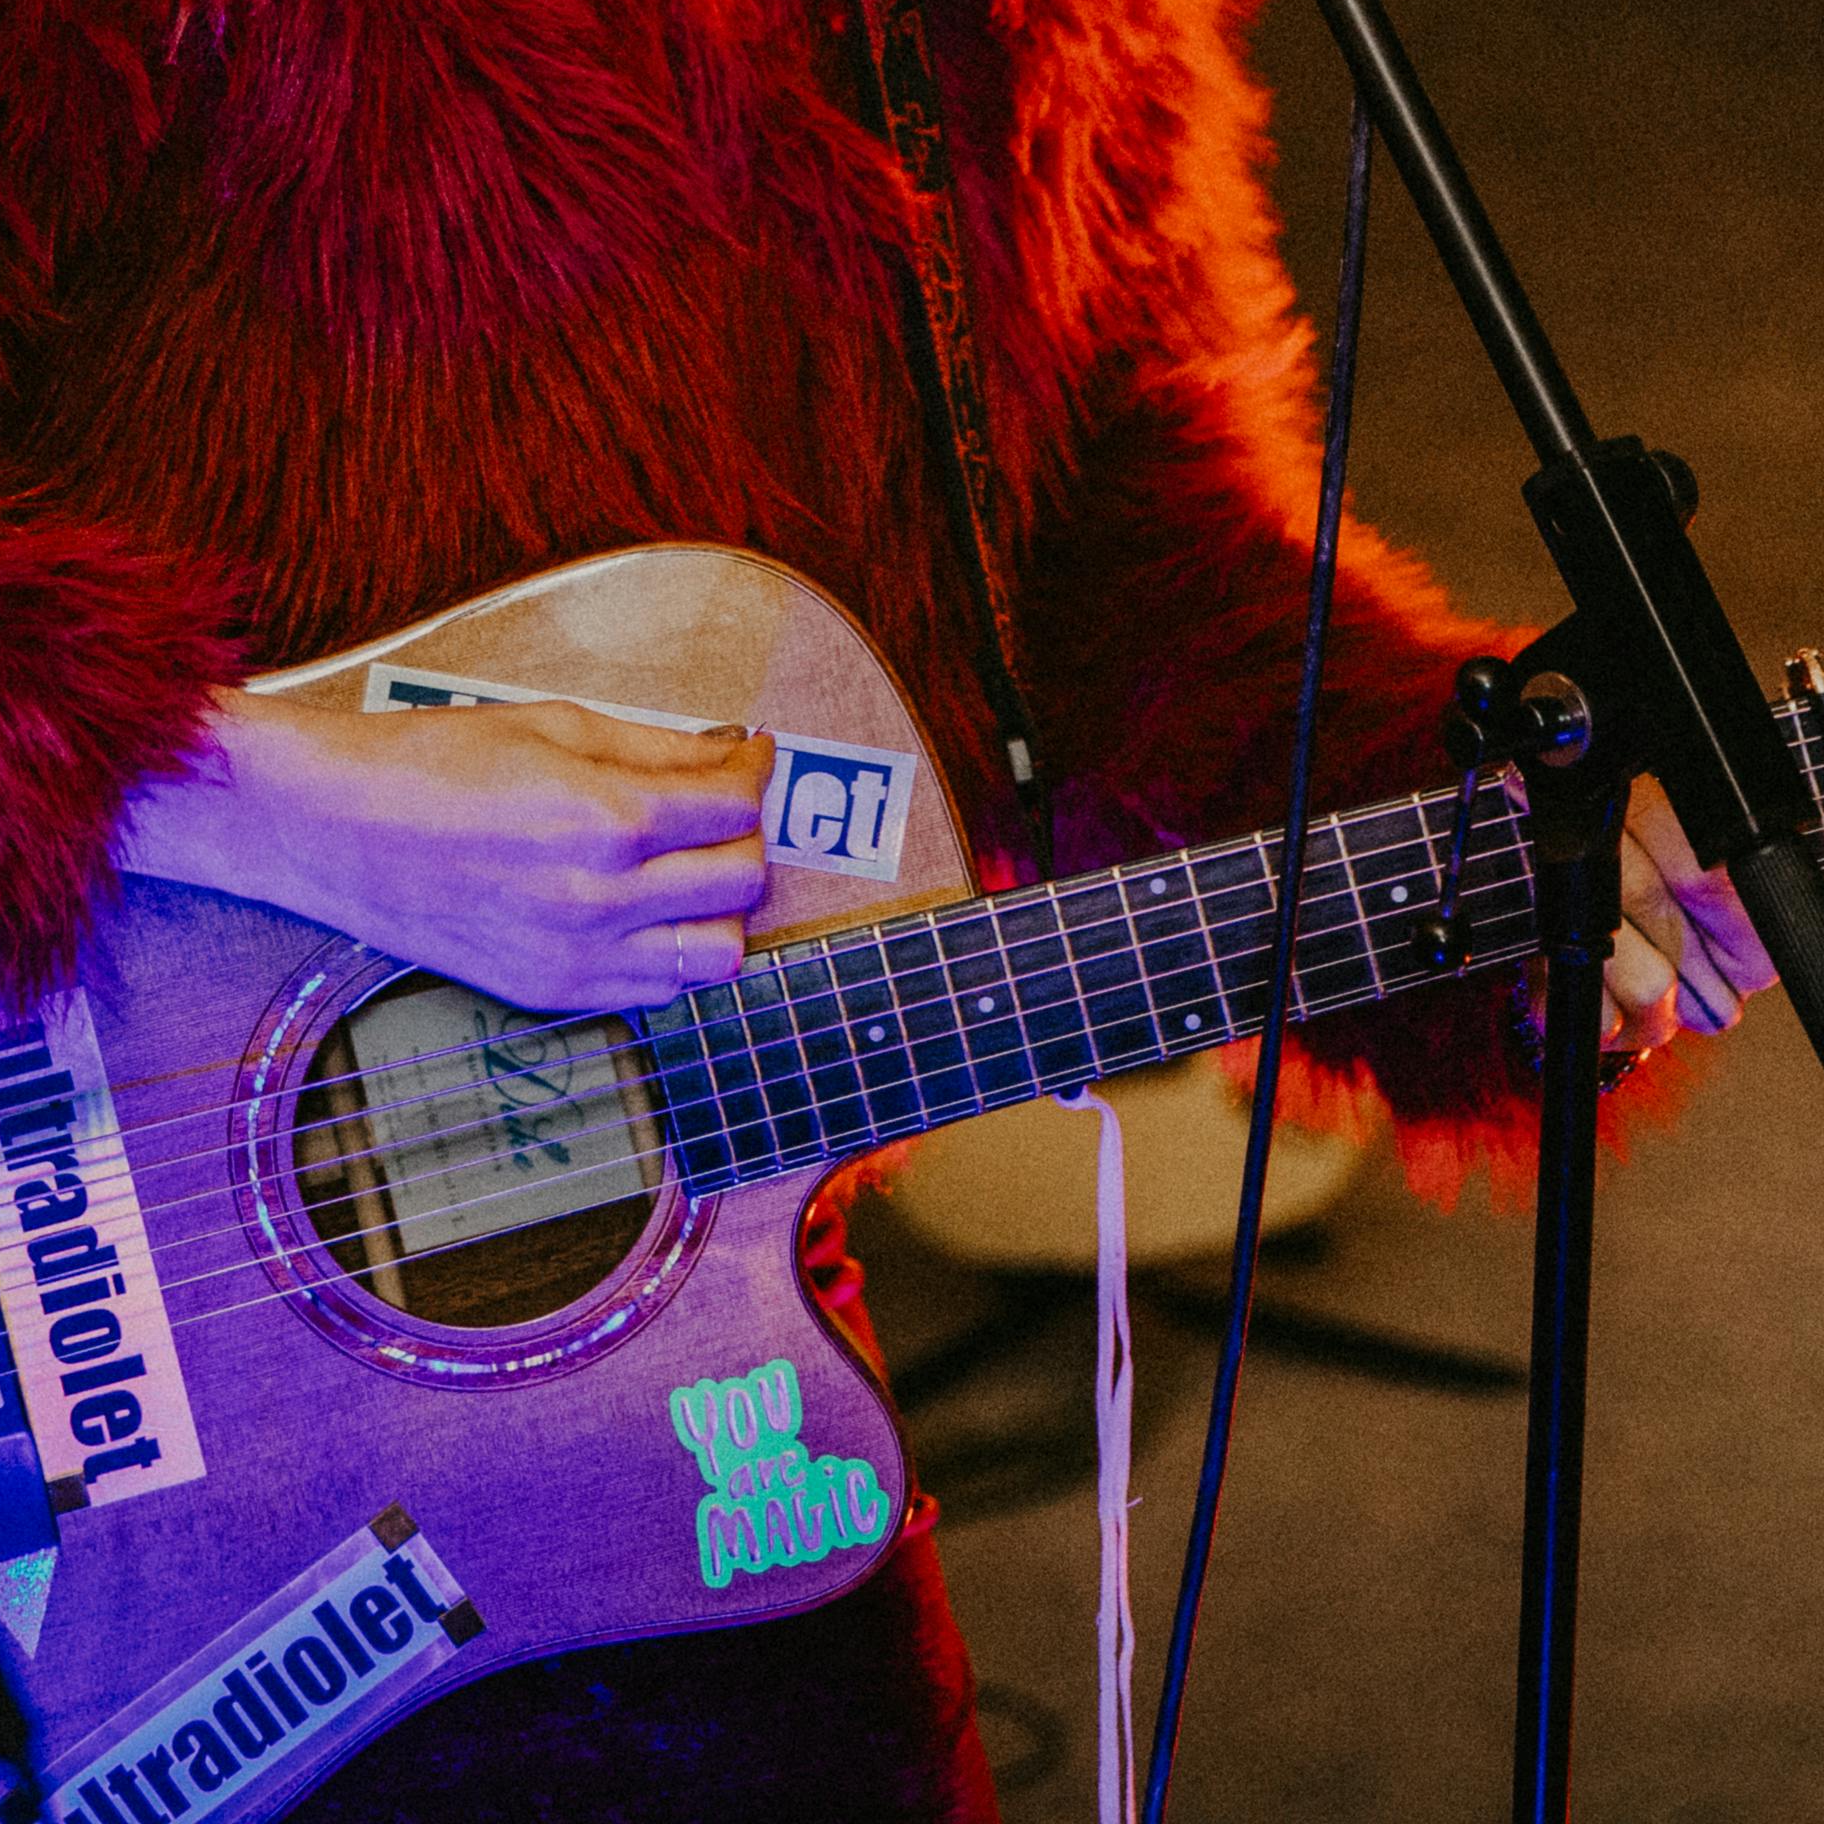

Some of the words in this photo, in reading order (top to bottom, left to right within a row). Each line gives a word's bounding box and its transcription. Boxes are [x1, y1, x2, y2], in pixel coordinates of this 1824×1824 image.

[680, 1369, 792, 1477] YOU
[728, 1450, 807, 1501] are
[64, 1552, 449, 1824] ltradiolet
